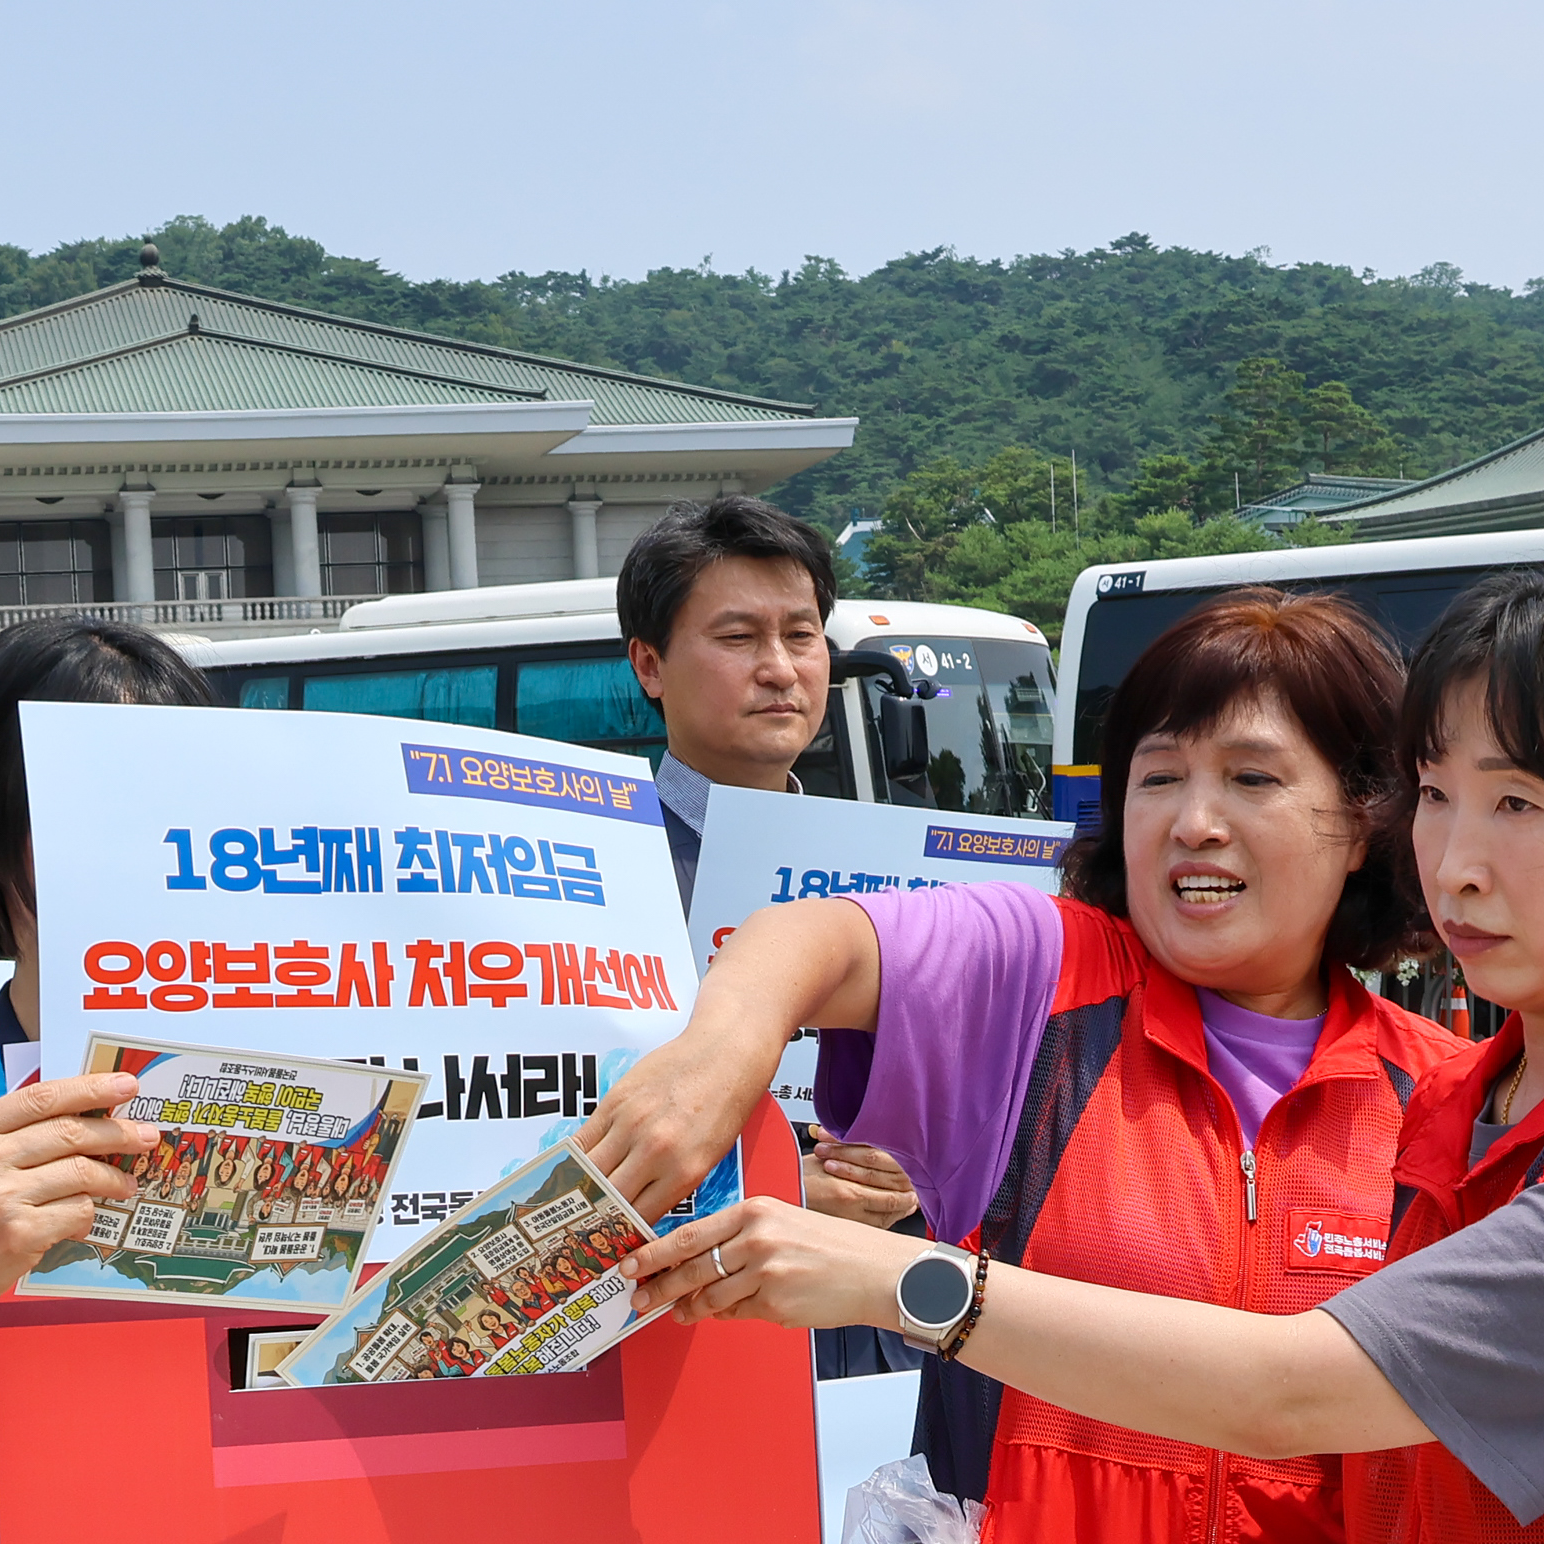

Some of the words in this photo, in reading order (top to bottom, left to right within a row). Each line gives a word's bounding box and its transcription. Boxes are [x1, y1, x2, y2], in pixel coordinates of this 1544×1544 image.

[1114, 574, 1142, 590] 41-1
[941, 652, 973, 670] 41-2
[459, 757, 605, 805] 요양보호사의
[606, 779, 637, 810] 날"
[956, 834, 1041, 858] 요양보호사의
[162, 826, 383, 895] 18년째
[395, 826, 606, 906] 최저임금
[82, 940, 396, 1012] 요양보호사
[405, 939, 679, 1011] 처우개선에
[179, 1074, 276, 1103] 행복해집니다!
[275, 1084, 324, 1112] 국민이
[192, 1101, 283, 1132] 돌봄노동자가
[286, 1112, 351, 1140] 대통령님,
[523, 1218, 532, 1228] 3.
[530, 1195, 575, 1225] 아동돌봄노동자
[470, 1250, 480, 1260] 2.
[478, 1231, 507, 1255] 요양보호사
[562, 1276, 625, 1321] 행복해야
